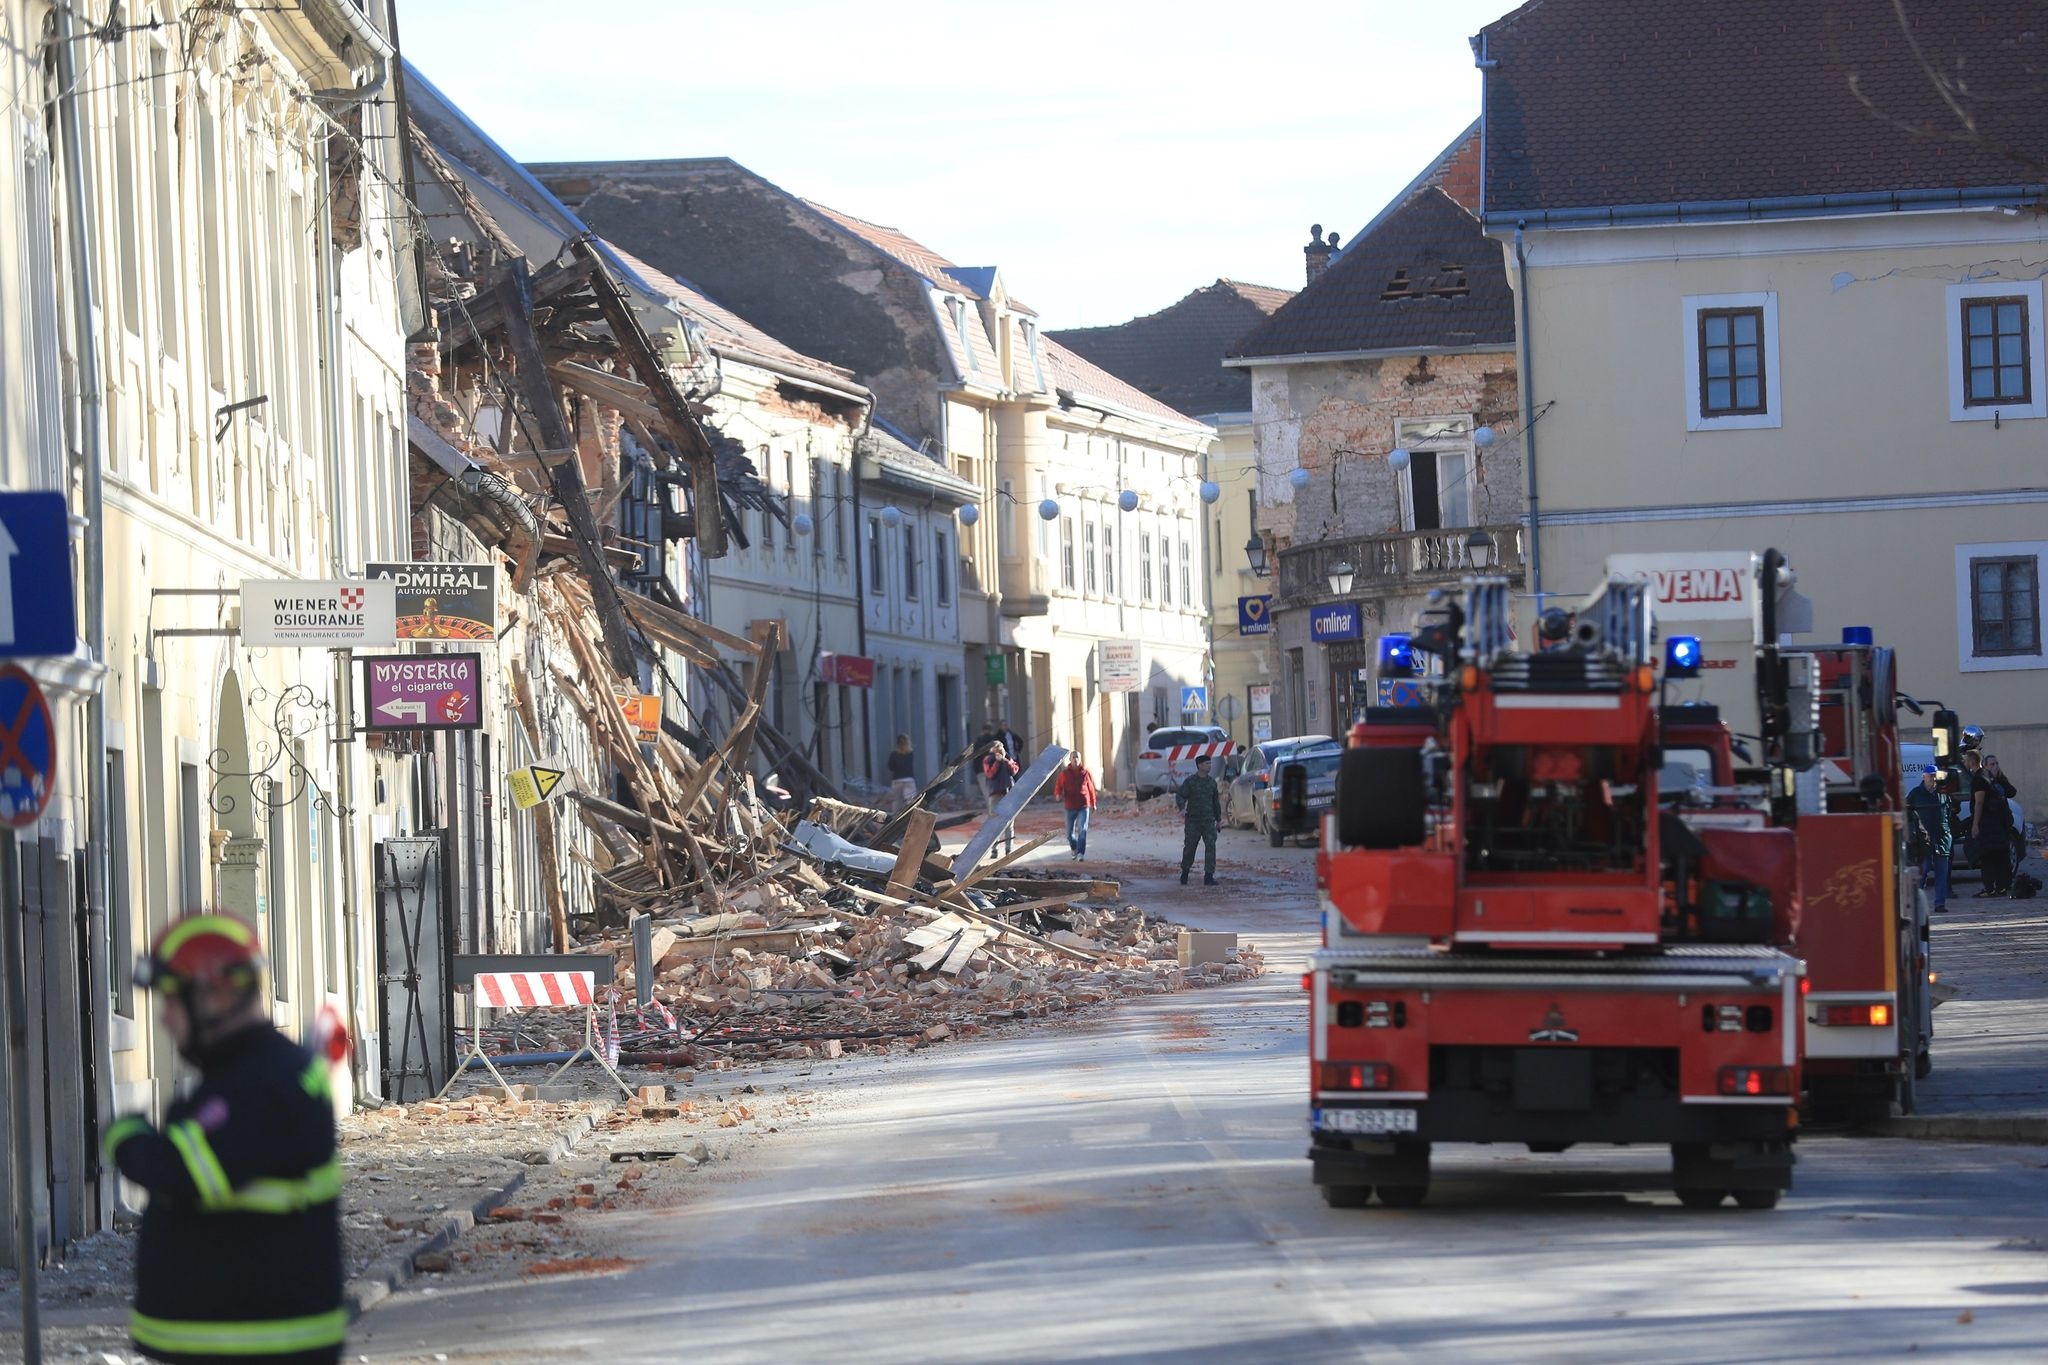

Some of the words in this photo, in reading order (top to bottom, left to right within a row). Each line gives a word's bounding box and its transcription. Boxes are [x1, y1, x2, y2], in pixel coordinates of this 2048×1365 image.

[377, 571, 488, 590] ADMIRAL
[397, 588, 443, 596] AUTOMAT
[445, 588, 468, 596] CLUB
[274, 599, 337, 611] WIENER
[274, 614, 364, 626] OSIGURANJE
[1323, 611, 1352, 634] mlinar
[376, 662, 468, 681] MYSTERIA
[391, 683, 402, 693] el
[407, 681, 454, 693] cigarete
